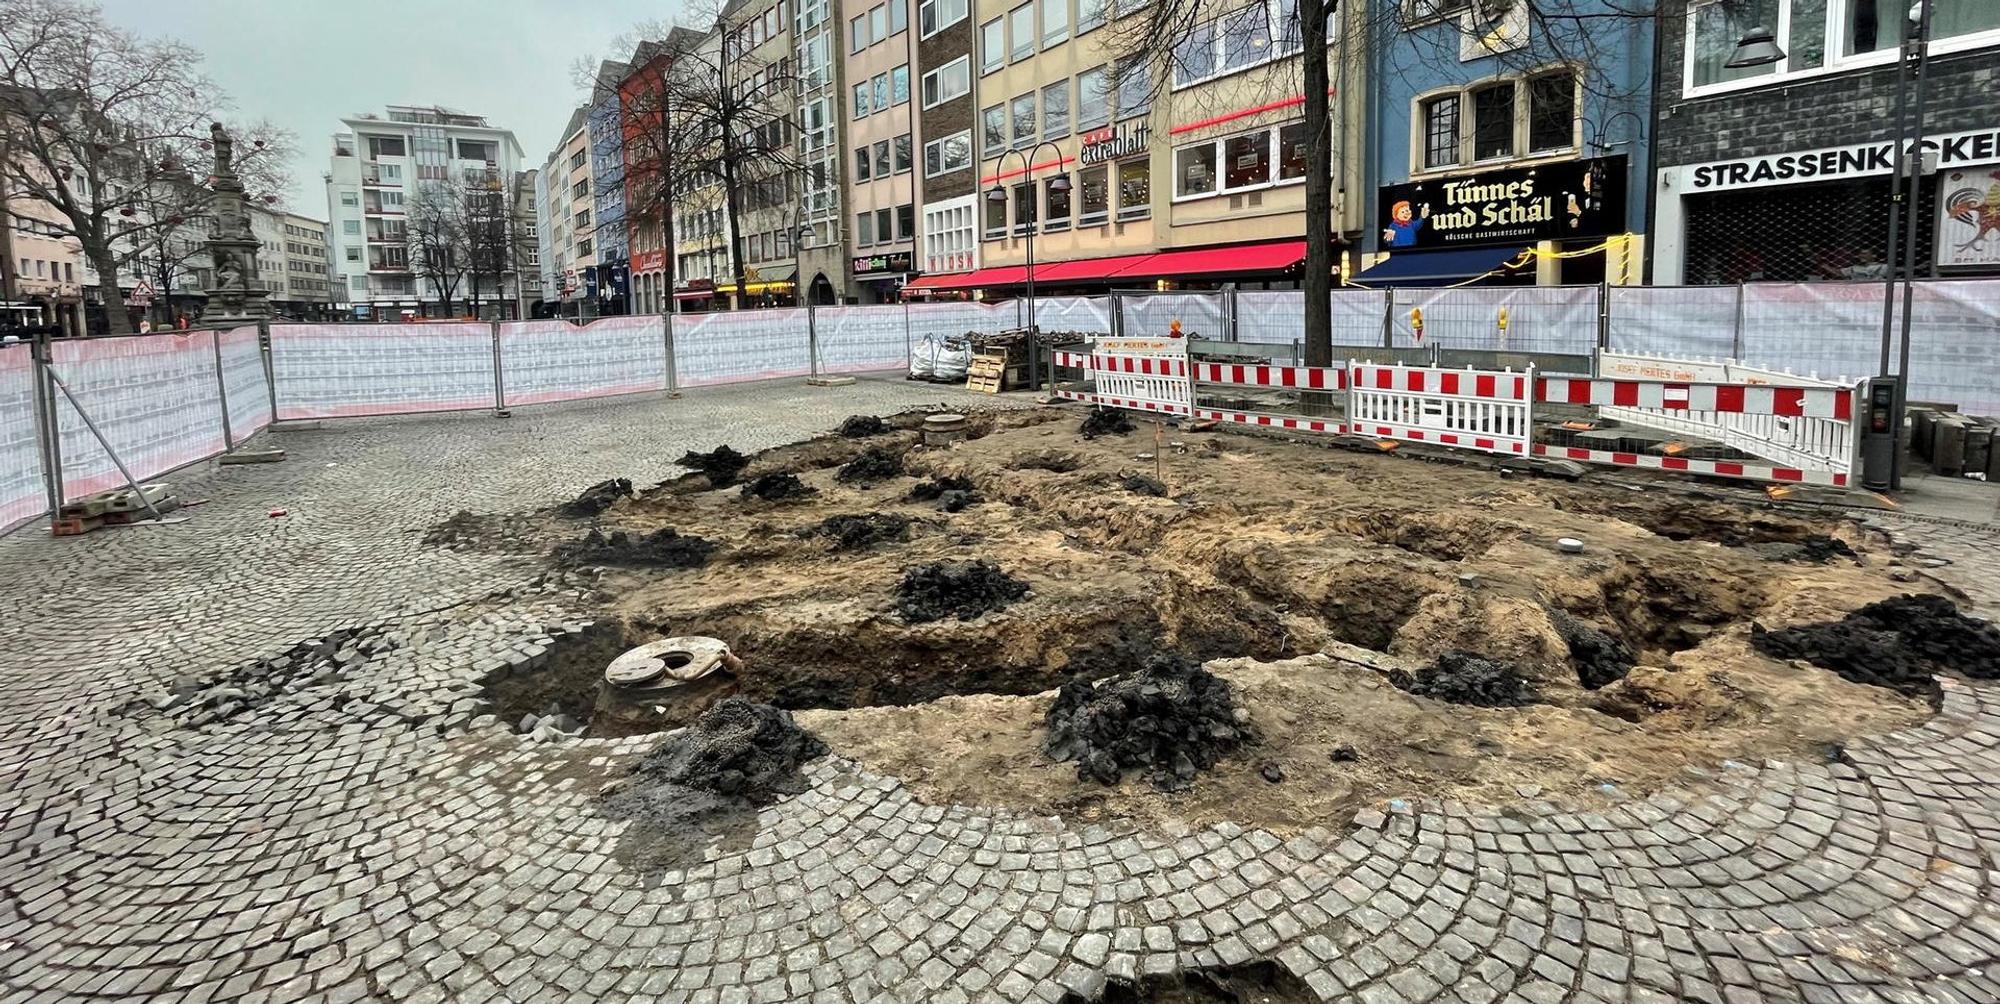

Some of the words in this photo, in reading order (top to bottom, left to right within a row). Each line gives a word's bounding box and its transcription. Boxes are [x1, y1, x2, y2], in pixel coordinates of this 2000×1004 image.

[1081, 120, 1152, 165] extrablatt
[1693, 132, 2000, 188] STRASSENKKE
[1442, 178, 1535, 206] Tünnes
[1431, 206, 1477, 230] und
[1481, 196, 1553, 226] Schäl
[930, 253, 974, 272] KIOSK
